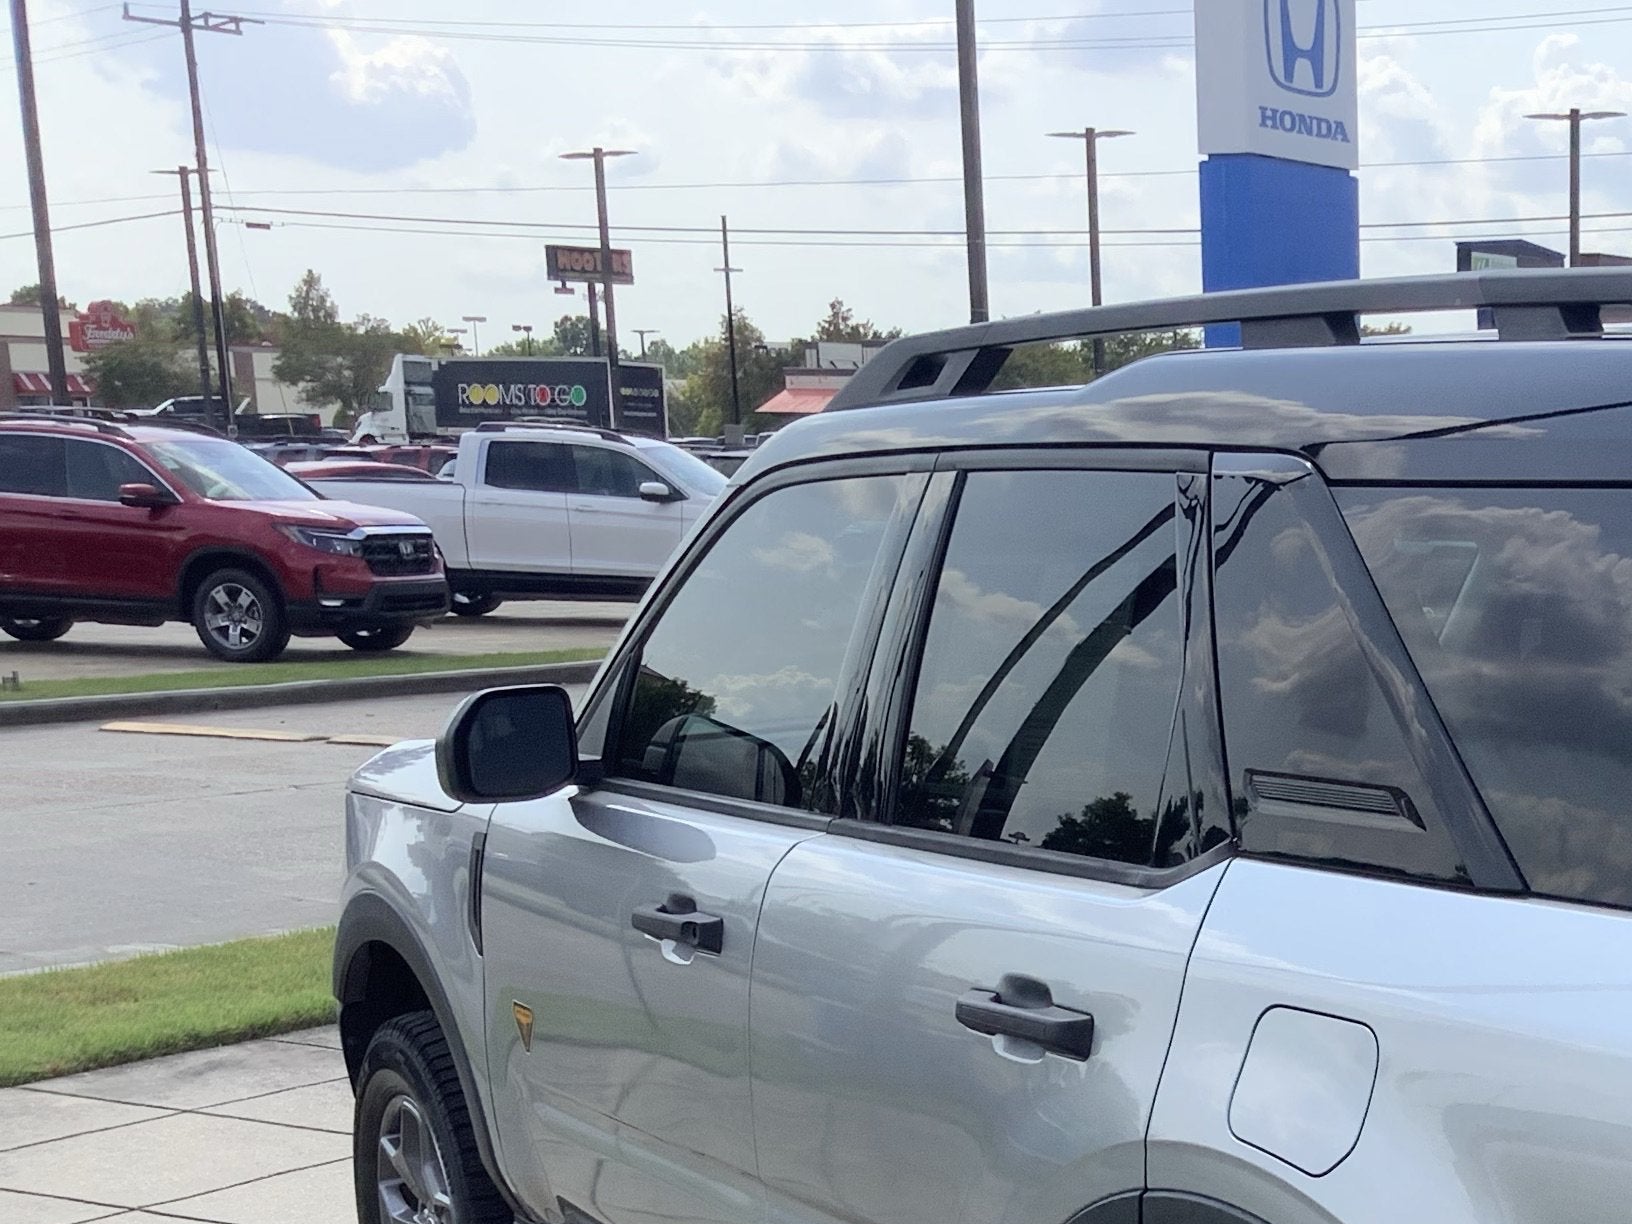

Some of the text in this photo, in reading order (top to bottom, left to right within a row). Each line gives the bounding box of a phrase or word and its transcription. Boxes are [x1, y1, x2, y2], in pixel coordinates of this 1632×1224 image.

[1258, 105, 1351, 143] HONDA
[556, 248, 634, 274] HOOTRS
[457, 383, 587, 407] ROOMS TO GO
